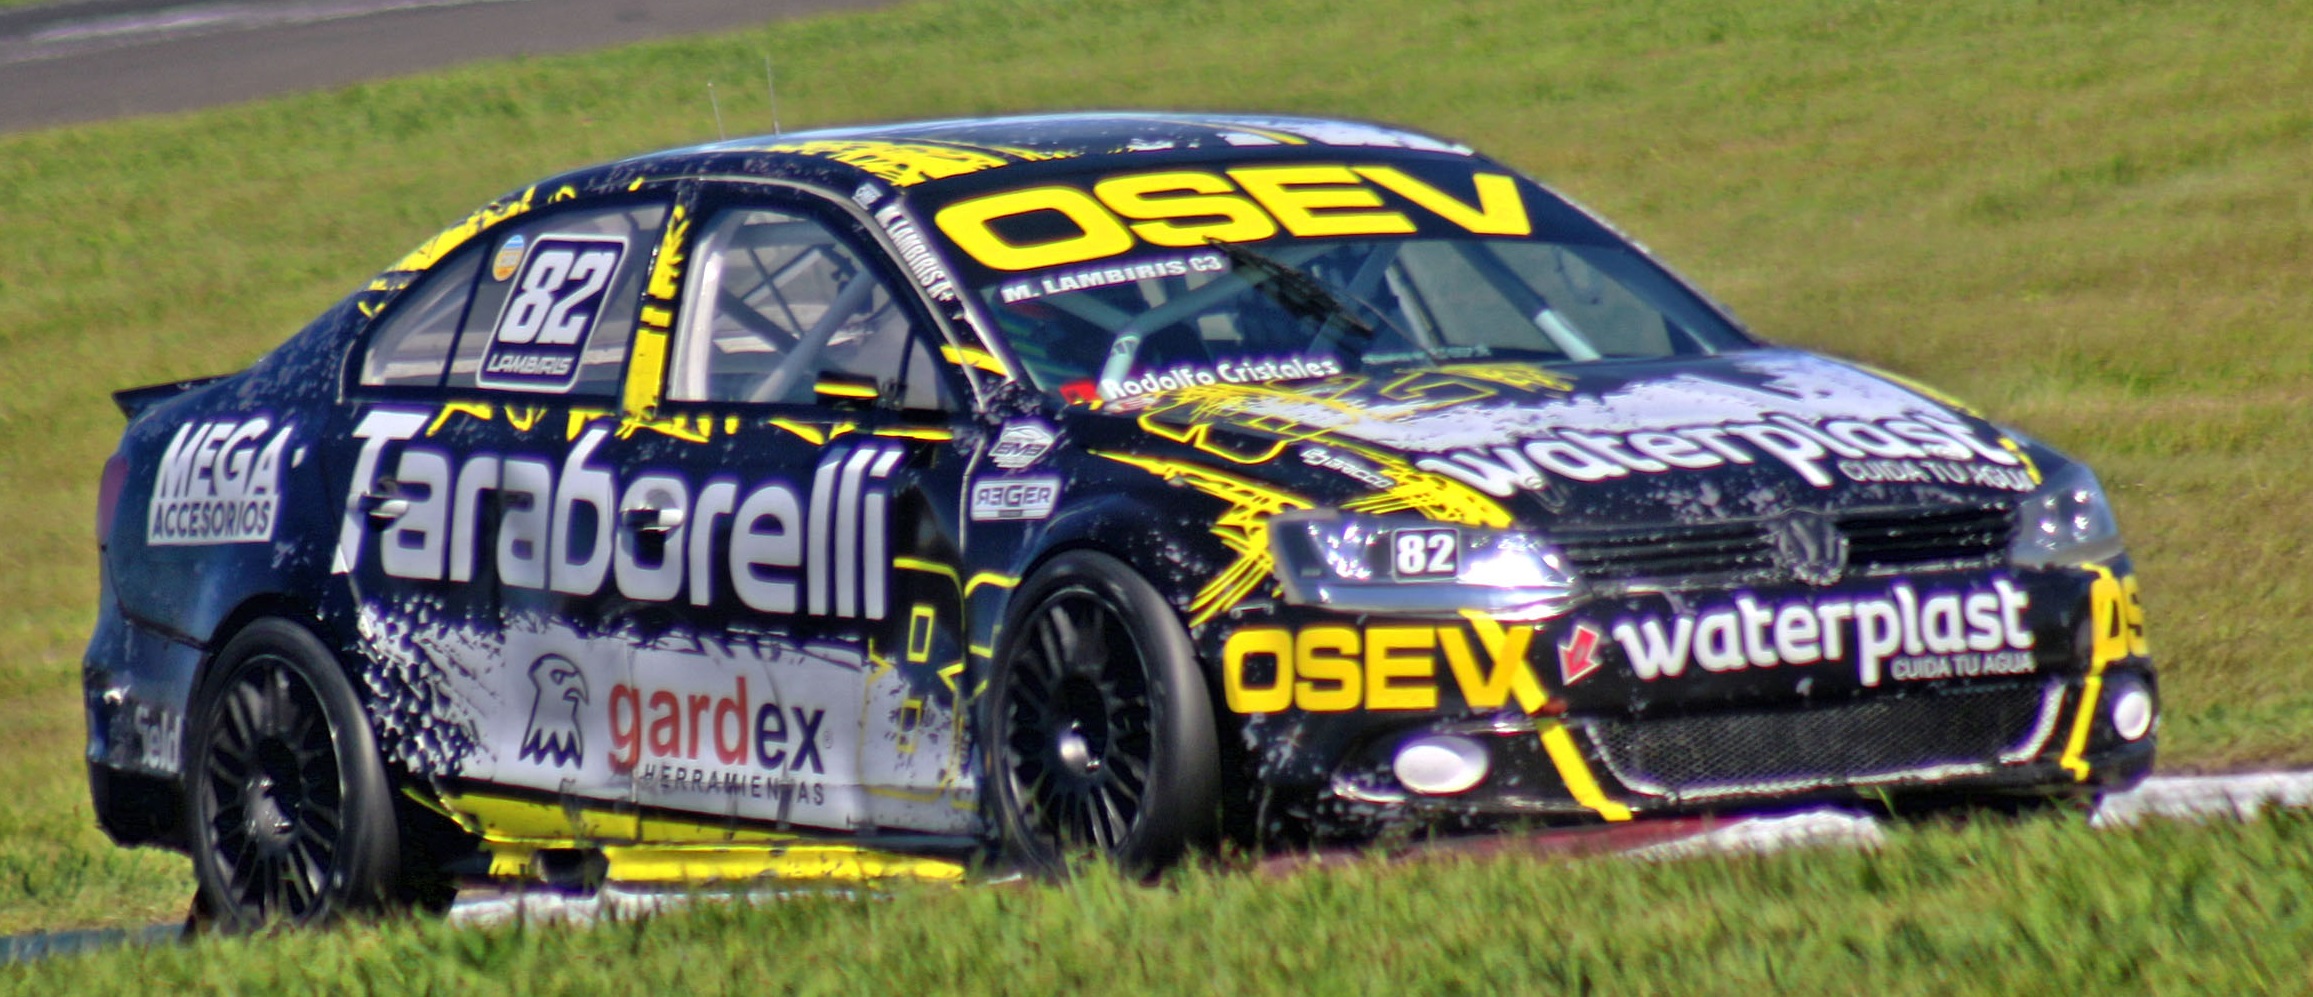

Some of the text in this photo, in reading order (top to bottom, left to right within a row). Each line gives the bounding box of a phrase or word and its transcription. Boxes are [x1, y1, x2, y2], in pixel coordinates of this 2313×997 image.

[886, 219, 946, 287] LAMBIRIS
[935, 165, 1531, 271] OSEV
[498, 250, 616, 344] 82
[1001, 255, 1223, 304] M. LAMBIRIS C3
[486, 354, 575, 376] LAMBIRIS
[1101, 357, 1341, 400] Rodolfo Cristales
[153, 416, 294, 498] MEGA
[1414, 410, 2021, 498] waterplast
[1837, 460, 1931, 483] CUIDA
[1920, 461, 1969, 485] TU
[151, 499, 271, 539] ACCESORIOS
[331, 410, 904, 620] Taraborelli
[1397, 533, 1455, 575] 82
[1223, 623, 1534, 714] OSEV
[1613, 579, 2035, 687] waterplast
[1890, 650, 2037, 681] CUIDA TU AGUA
[608, 676, 826, 776] gardex
